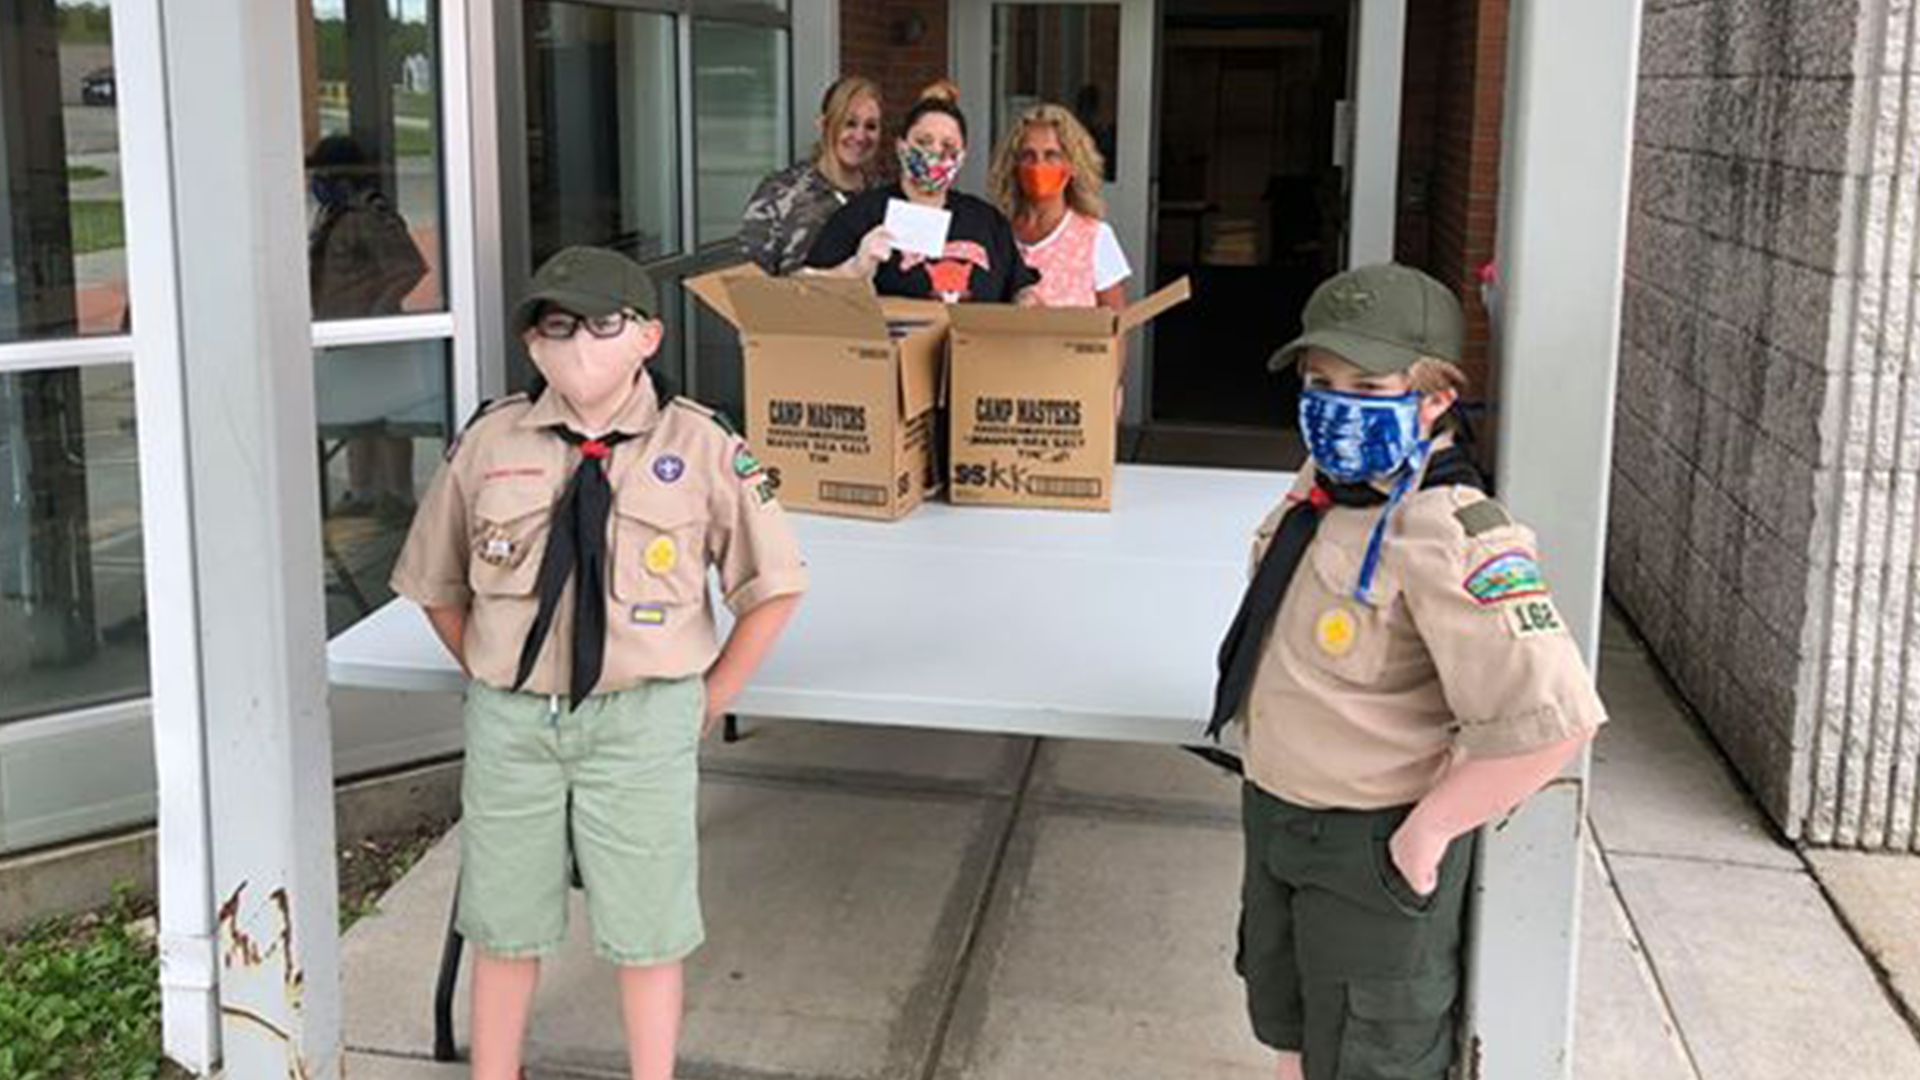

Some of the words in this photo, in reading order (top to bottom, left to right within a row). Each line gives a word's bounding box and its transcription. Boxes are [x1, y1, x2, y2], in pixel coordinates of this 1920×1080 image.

[769, 399, 803, 426] CAMP
[806, 402, 866, 432] MASTERS
[975, 396, 1012, 423] CAMP
[1016, 398, 1081, 426] MASTERS
[841, 442, 871, 455] SALT
[1053, 438, 1085, 448] SALT
[1515, 601, 1560, 632] 162
